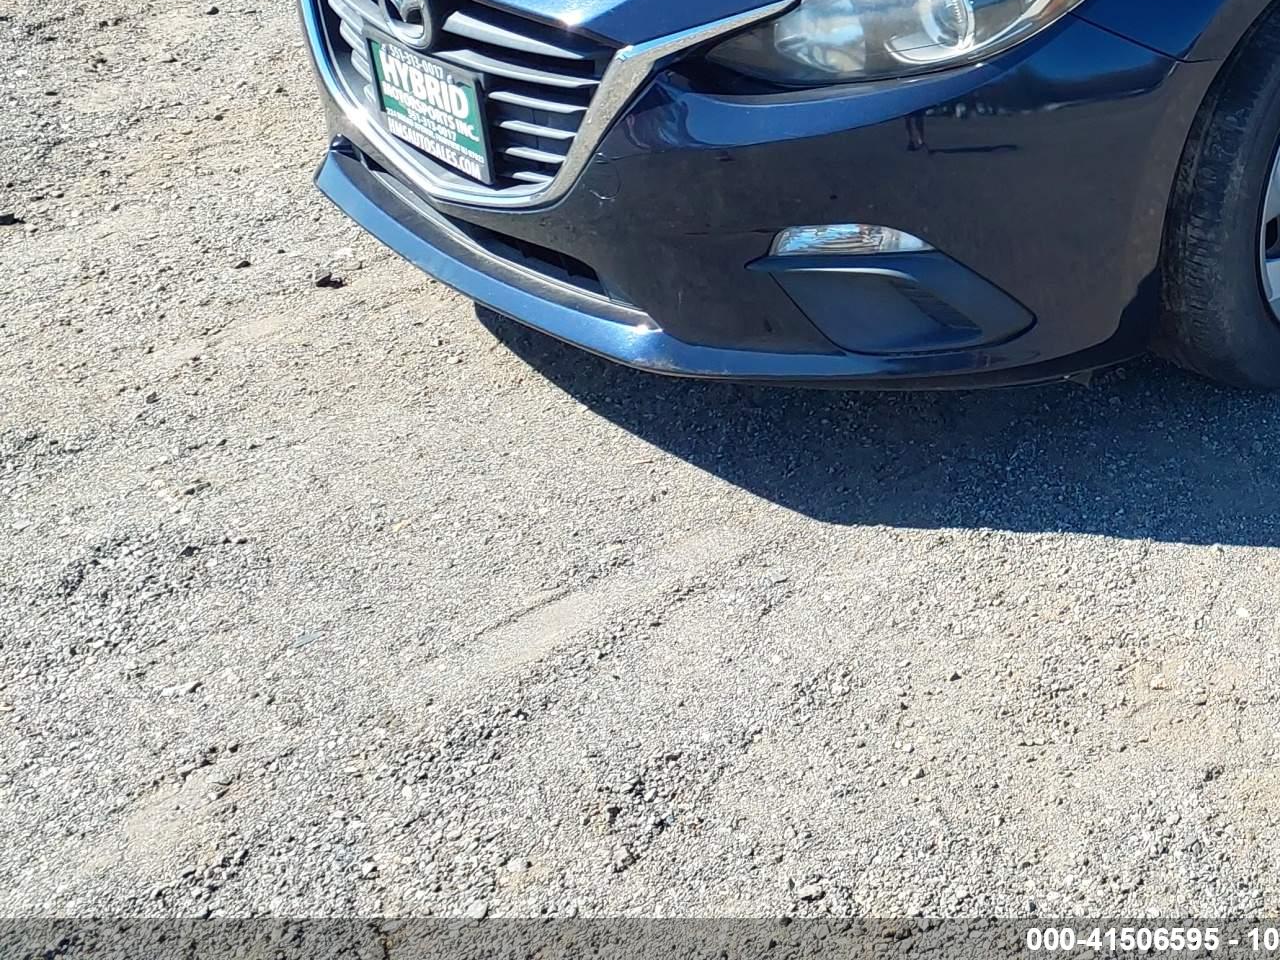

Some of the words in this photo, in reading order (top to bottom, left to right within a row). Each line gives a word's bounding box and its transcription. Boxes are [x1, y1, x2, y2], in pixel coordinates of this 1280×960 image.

[379, 46, 469, 119] HYBRID
[382, 80, 456, 130] MOTORSPORTS
[387, 115, 482, 180] HMSAUTOSALES.COM
